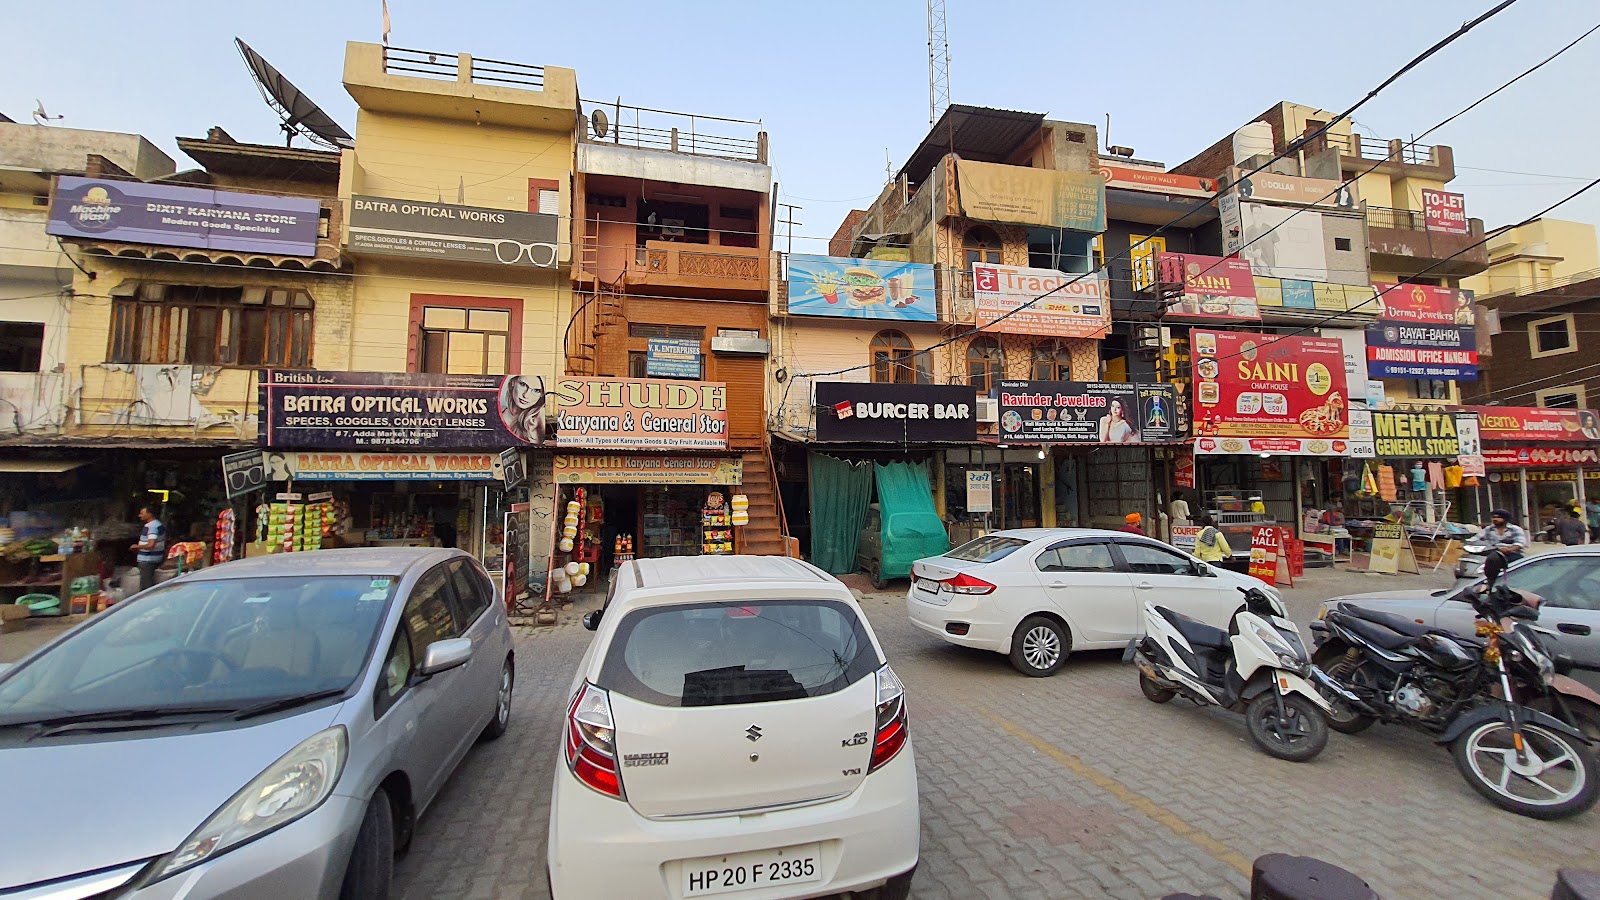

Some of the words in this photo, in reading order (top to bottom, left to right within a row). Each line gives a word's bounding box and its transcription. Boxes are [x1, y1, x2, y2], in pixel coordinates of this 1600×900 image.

[1133, 174, 1157, 182] KWALITY
[1268, 181, 1295, 191] DOLLAR
[1424, 192, 1463, 208] TO-LET
[70, 203, 121, 214] Machine
[146, 203, 185, 214] DIXIT
[187, 207, 251, 221] KARYANA
[254, 213, 297, 225] STORE
[354, 200, 398, 213] BATRA
[401, 204, 456, 219] OPTICAL
[459, 210, 505, 224] WORKS
[1426, 206, 1441, 218] For
[1443, 209, 1464, 221] Rent
[79, 212, 110, 221] Wash
[162, 217, 199, 227] Modern
[201, 221, 231, 230] Goods
[234, 223, 280, 234] Specialist
[414, 240, 442, 248] CONTACT
[443, 242, 466, 250] LENSES
[1000, 268, 1098, 296] Trackon
[1186, 274, 1231, 290] SAINI
[1040, 315, 1103, 326] ENTERPRISES
[1388, 306, 1416, 317] Verma
[1417, 308, 1454, 321] Jewellers
[1400, 327, 1460, 341] RAYAT-BAHRA
[661, 345, 700, 354] ENTERPRISES
[1376, 348, 1416, 362] ADMISSION
[1418, 350, 1442, 363] OFFICE
[1444, 352, 1471, 364] NANGAL
[275, 372, 314, 383] British
[1238, 360, 1298, 382] SAINI
[1315, 372, 1320, 382] 1
[557, 380, 726, 412] SHUDH
[1001, 393, 1052, 406] Ravinder
[1054, 393, 1106, 407] Jewellers
[283, 395, 346, 413] BATRA
[351, 395, 422, 414] OPTICAL
[426, 397, 488, 415] WORKS
[934, 403, 970, 419] BAR
[285, 417, 333, 426] SPECES,
[335, 417, 391, 427] GOGGLES,
[394, 417, 443, 426] CONTACT
[445, 418, 485, 427] LENSES
[557, 410, 619, 434] Karyana
[622, 411, 635, 431] &
[641, 411, 696, 433] General
[1374, 413, 1456, 437] MEHTA
[1522, 419, 1562, 431] Jewellers
[1376, 438, 1425, 455] GENERAL
[1426, 439, 1459, 455] STORE
[298, 454, 355, 471] BATRA
[359, 455, 430, 471] OPTICAL
[433, 455, 492, 470] WORKS
[555, 455, 622, 469] Shudh
[625, 456, 661, 471] Karyana
[663, 457, 695, 469] General
[697, 457, 716, 469] Store
[970, 473, 990, 481] रेकी
[1258, 527, 1273, 537] AC
[1251, 536, 1278, 546] HALL
[842, 737, 868, 748] K10
[623, 752, 669, 761] MARUTI
[623, 757, 669, 768] SUZUKI
[689, 870, 719, 892] HP
[722, 867, 746, 887] 20
[752, 864, 764, 883] F
[769, 858, 815, 881] 2335
